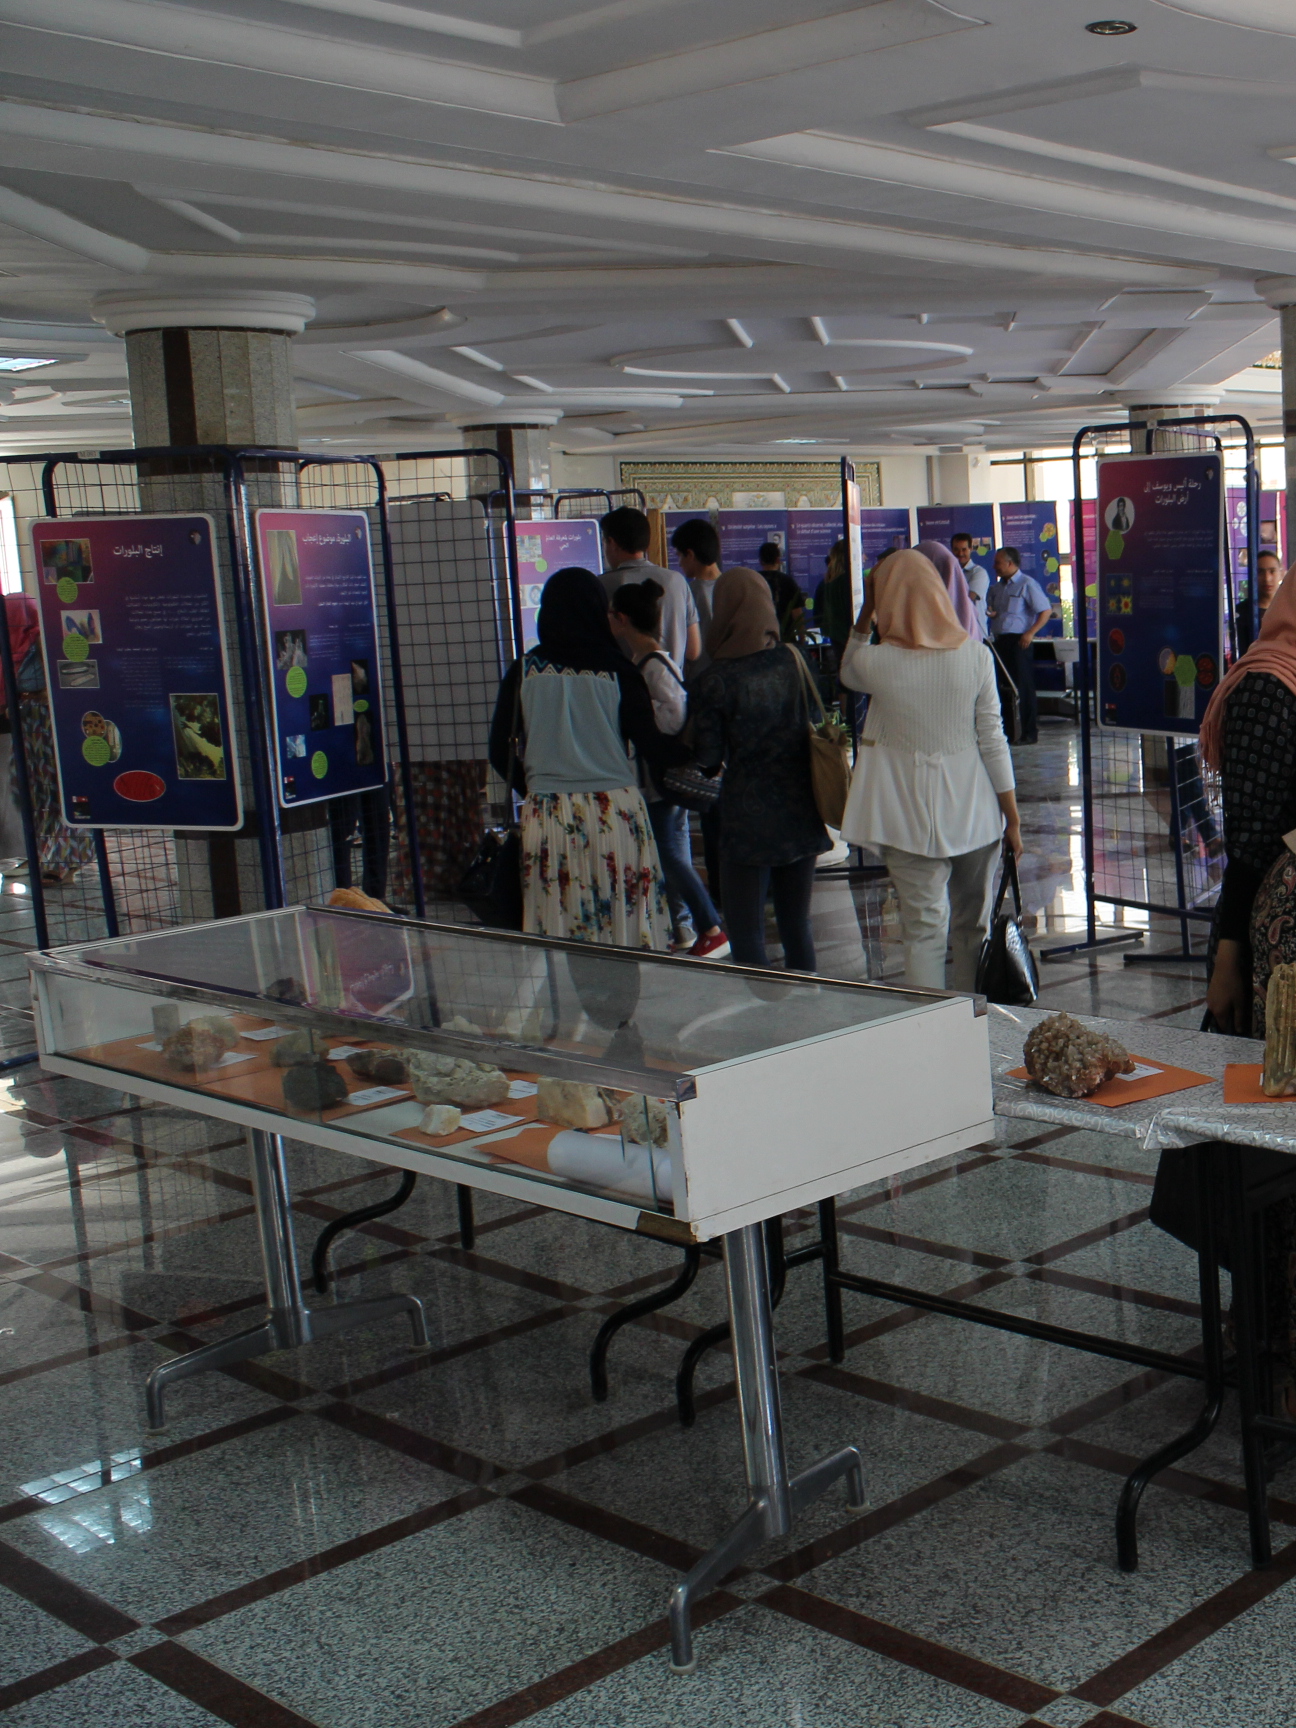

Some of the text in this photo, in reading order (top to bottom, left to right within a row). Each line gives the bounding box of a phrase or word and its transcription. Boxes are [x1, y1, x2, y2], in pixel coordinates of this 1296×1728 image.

[1154, 493, 1176, 506] البلورات
[113, 544, 164, 559] إنتاج البلورات
